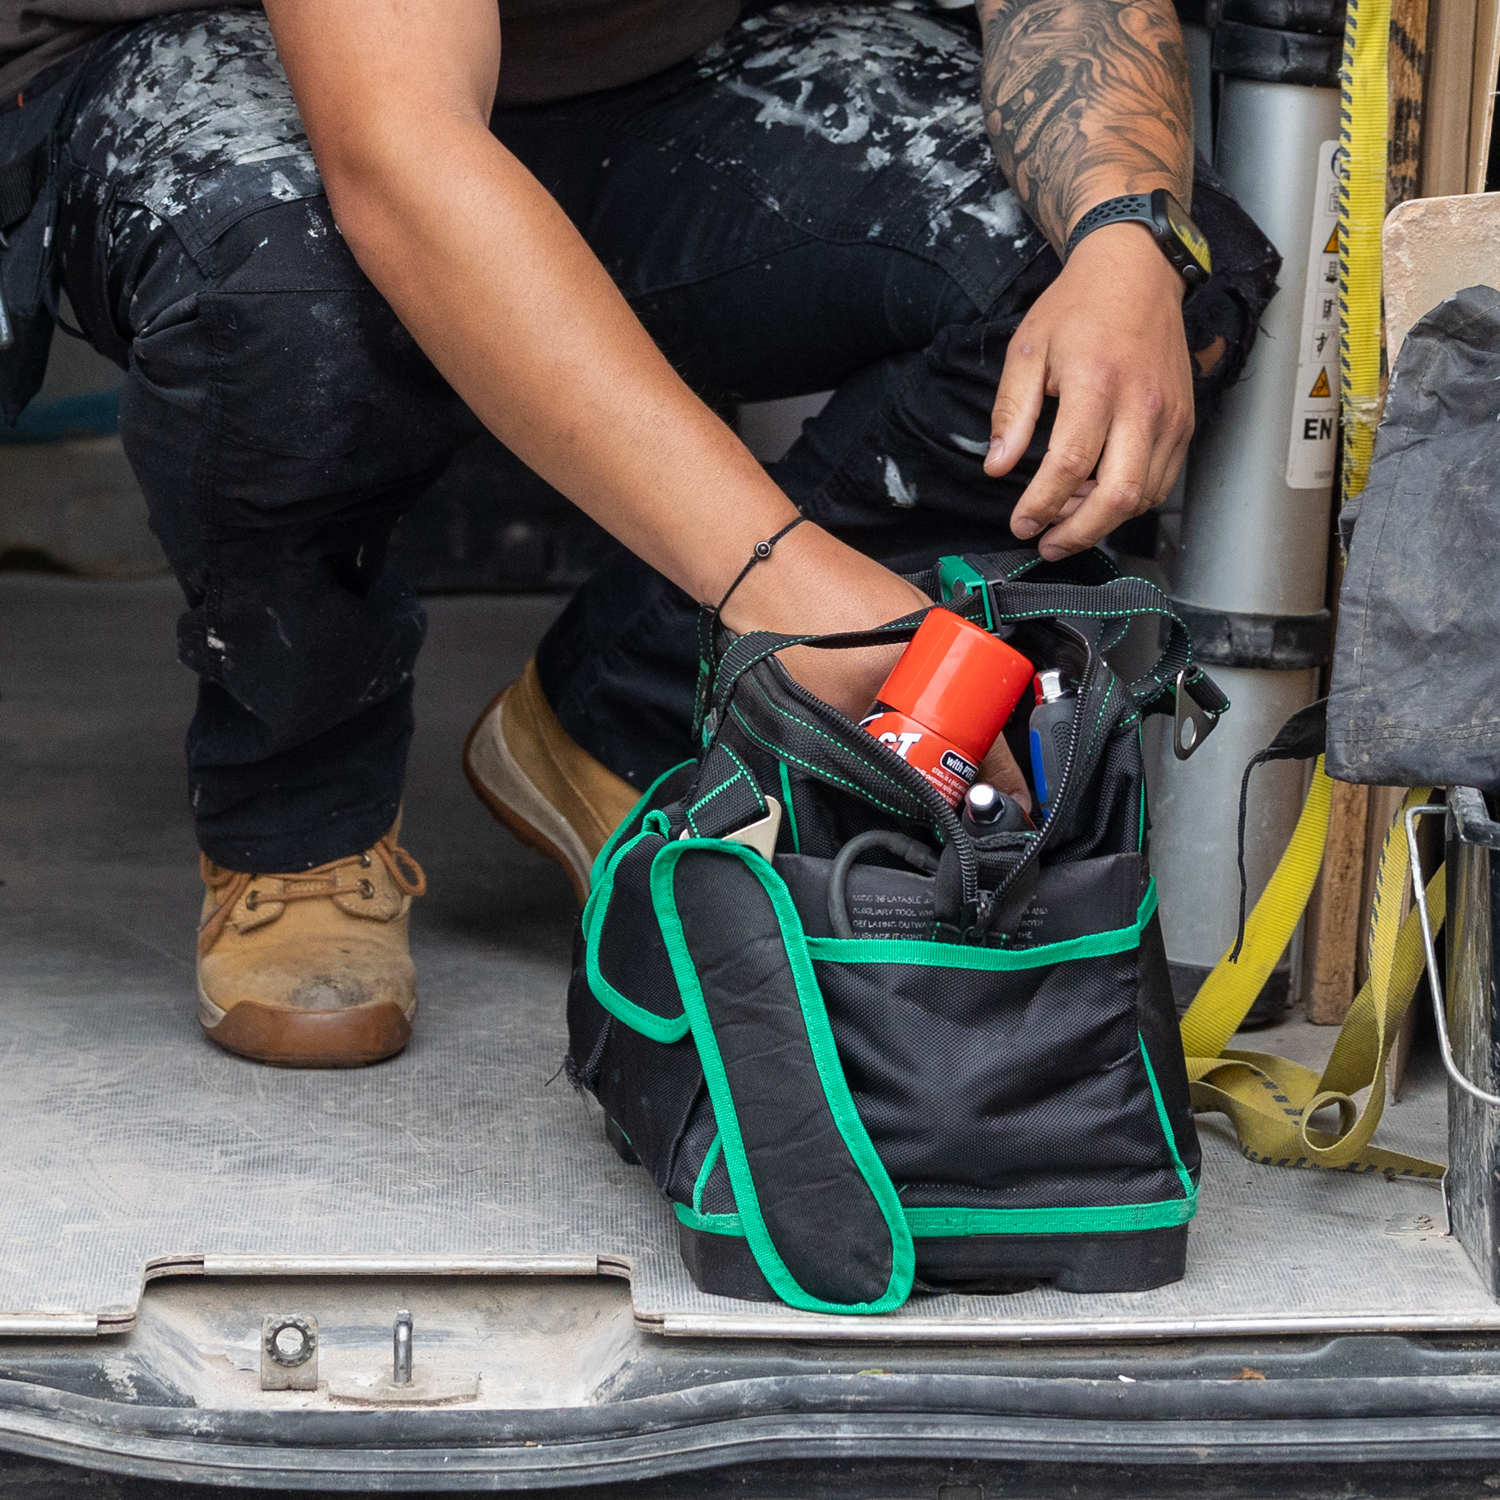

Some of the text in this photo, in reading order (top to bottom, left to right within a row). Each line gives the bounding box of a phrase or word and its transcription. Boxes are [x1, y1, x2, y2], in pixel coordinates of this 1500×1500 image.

[1303, 418, 1333, 440] EN
[946, 756, 964, 773] with
[894, 908, 917, 917] TOOL
